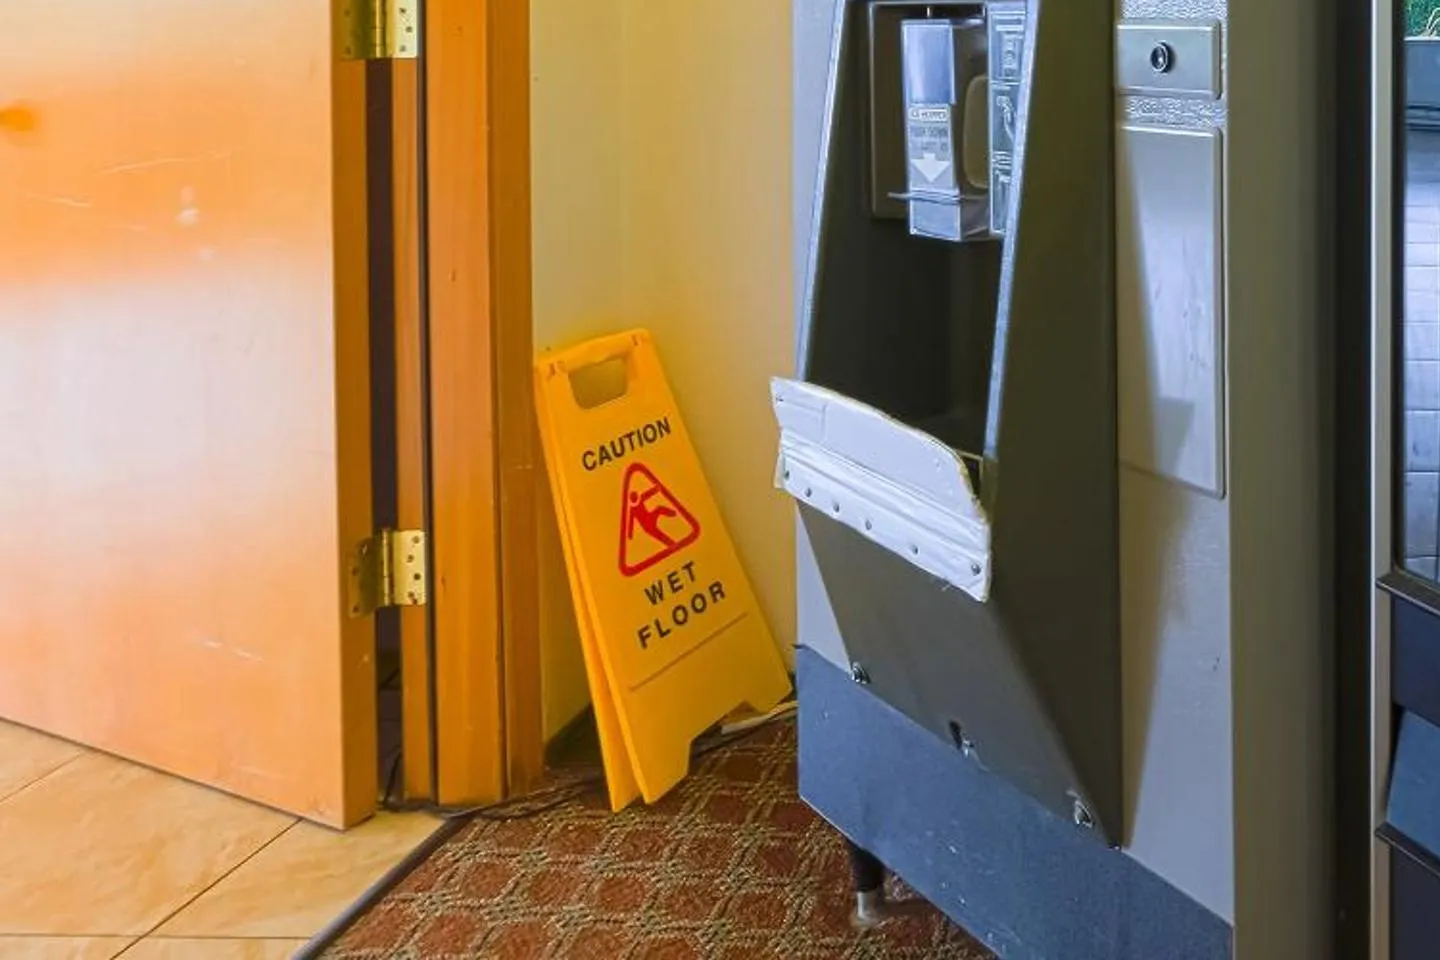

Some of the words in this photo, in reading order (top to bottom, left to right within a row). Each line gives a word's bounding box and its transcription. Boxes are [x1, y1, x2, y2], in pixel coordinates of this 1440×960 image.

[581, 416, 672, 472] CAUTION
[644, 561, 698, 606] WET
[637, 580, 726, 650] FLOOR
